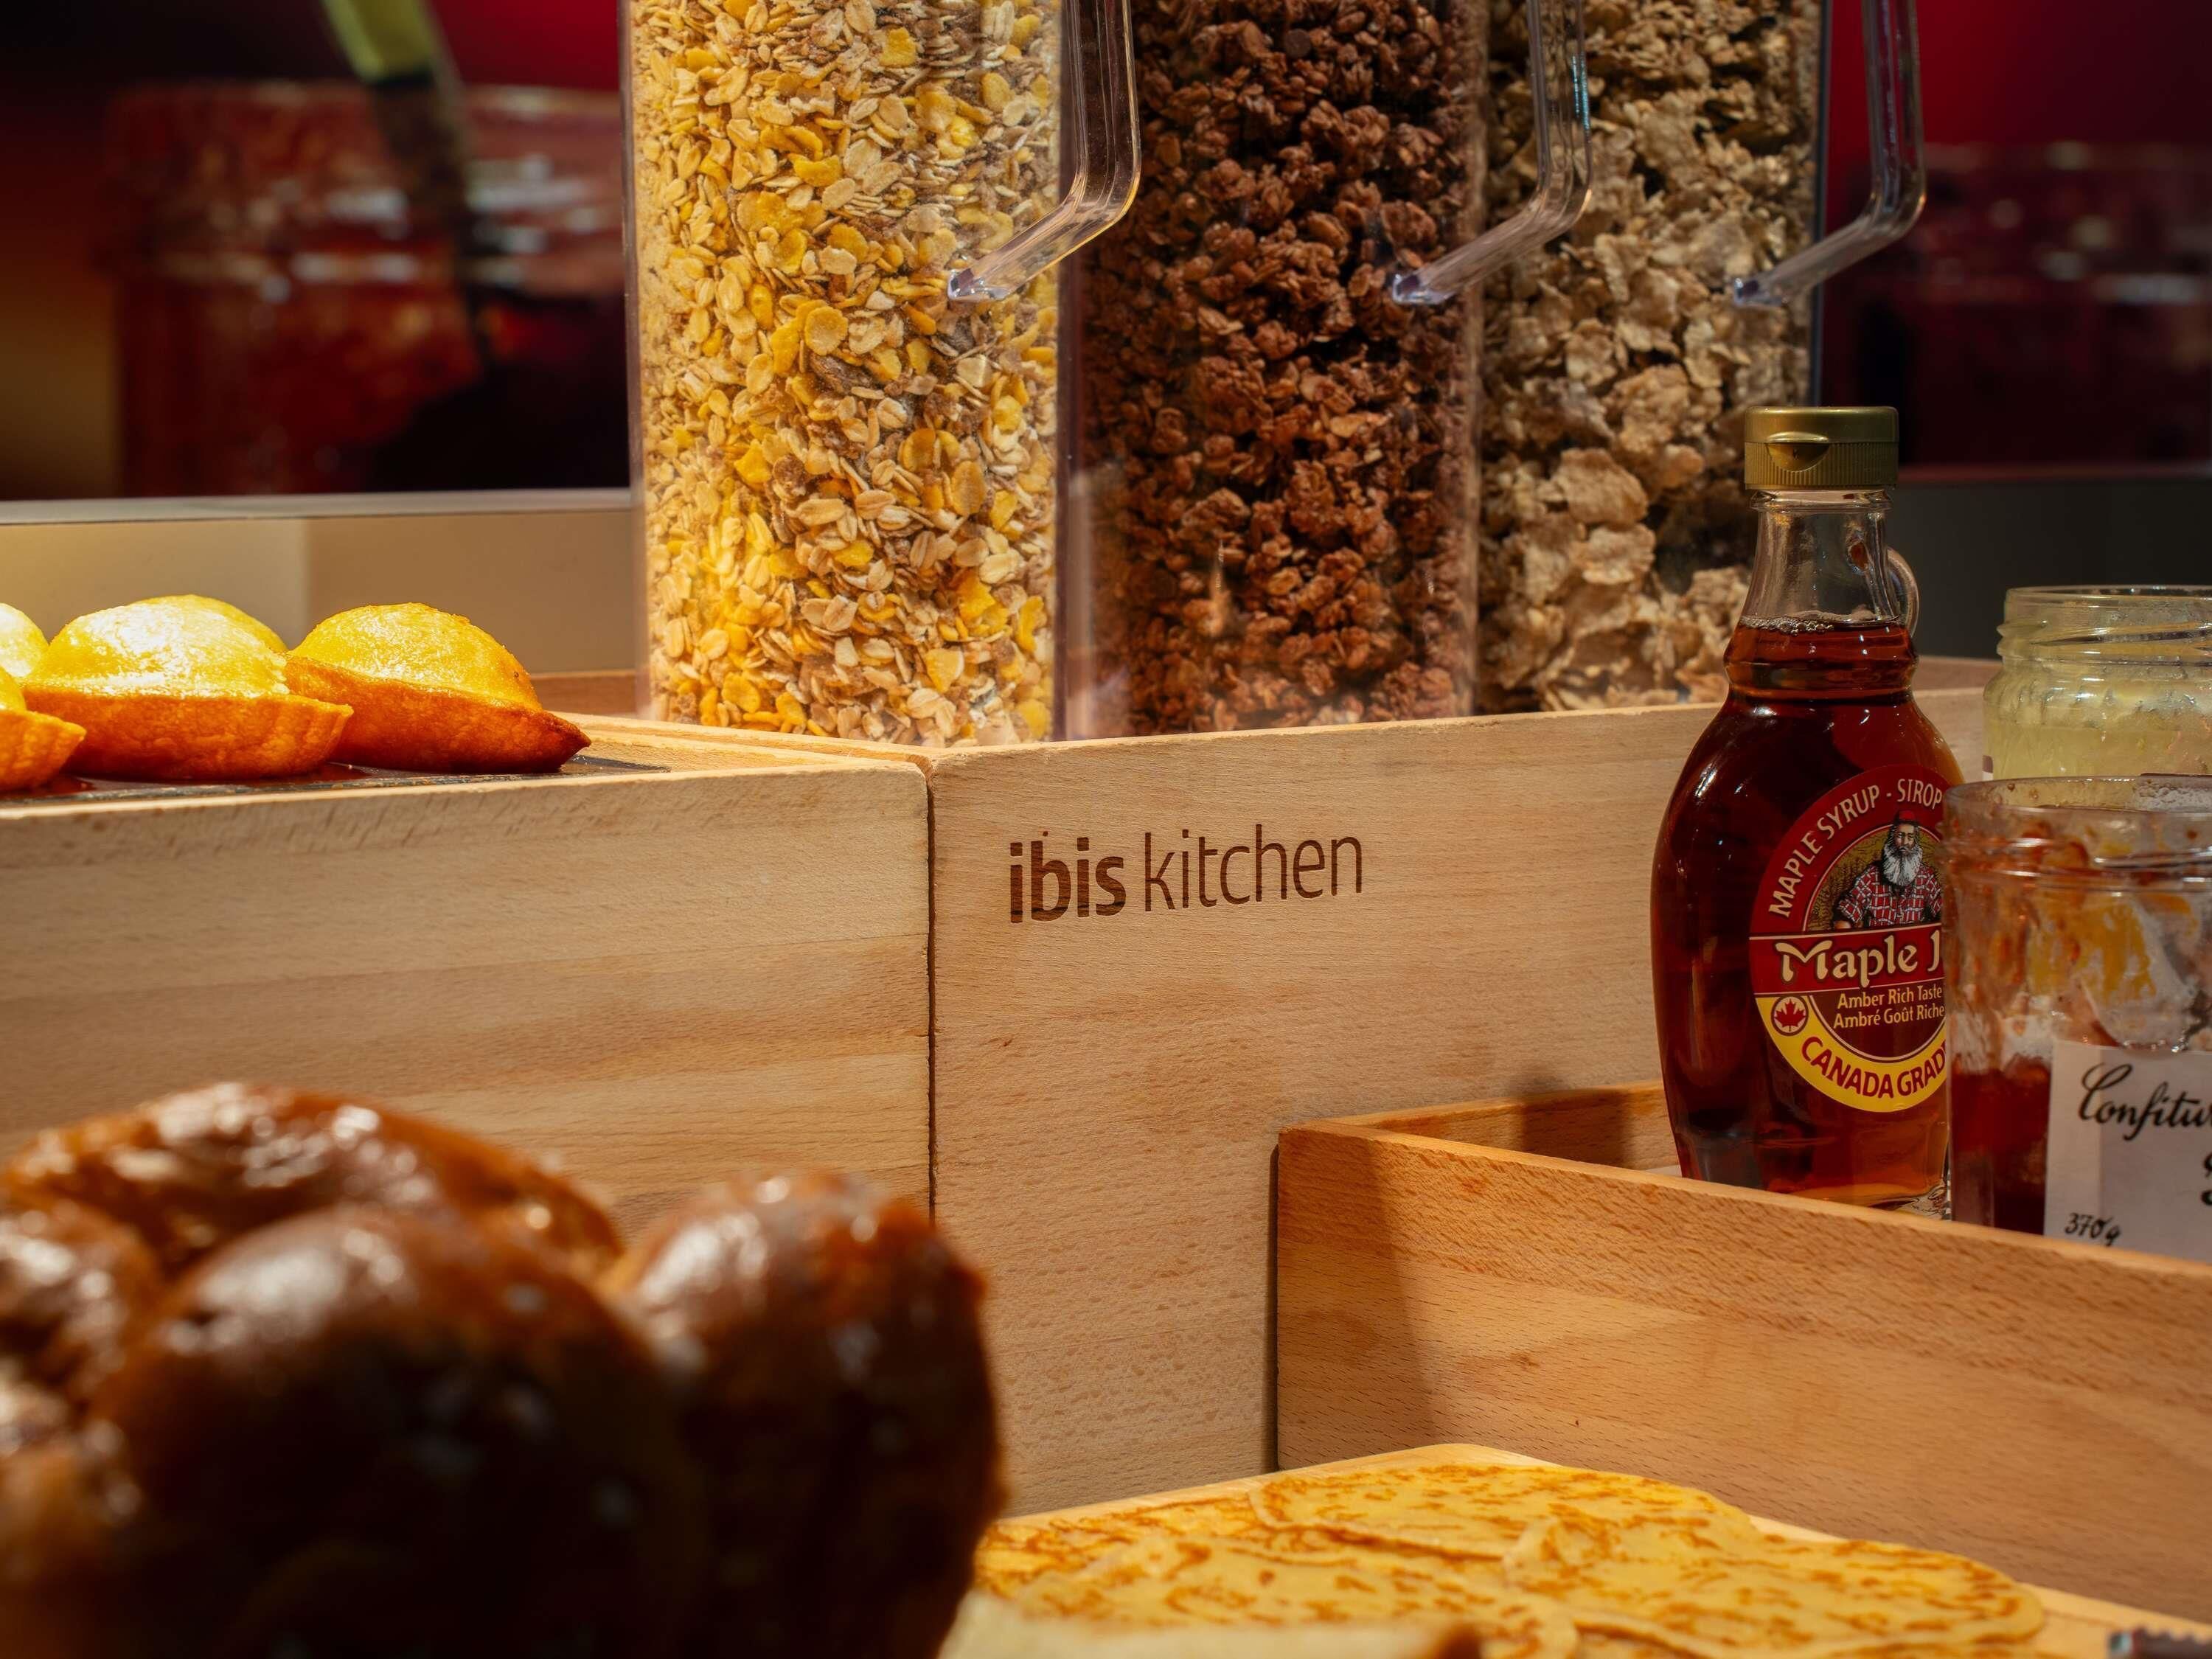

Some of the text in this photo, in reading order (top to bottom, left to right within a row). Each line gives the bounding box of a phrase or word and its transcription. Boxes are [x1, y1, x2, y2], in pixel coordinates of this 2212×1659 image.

[1009, 823, 1363, 923] ibis kitchen
[1768, 832, 1823, 918] MAPLE
[1817, 785, 1881, 840] SYRUP
[1897, 778, 1943, 810] SIROP
[1774, 934, 1919, 989] Maple
[1832, 1003, 1946, 1030] Ambré Goût Riche
[1837, 984, 1943, 1010] Amber Rich Taste
[1801, 1036, 1894, 1099] CANADA
[2078, 1062, 2212, 1141] Confitu
[2064, 1212, 2122, 1248] 370g
